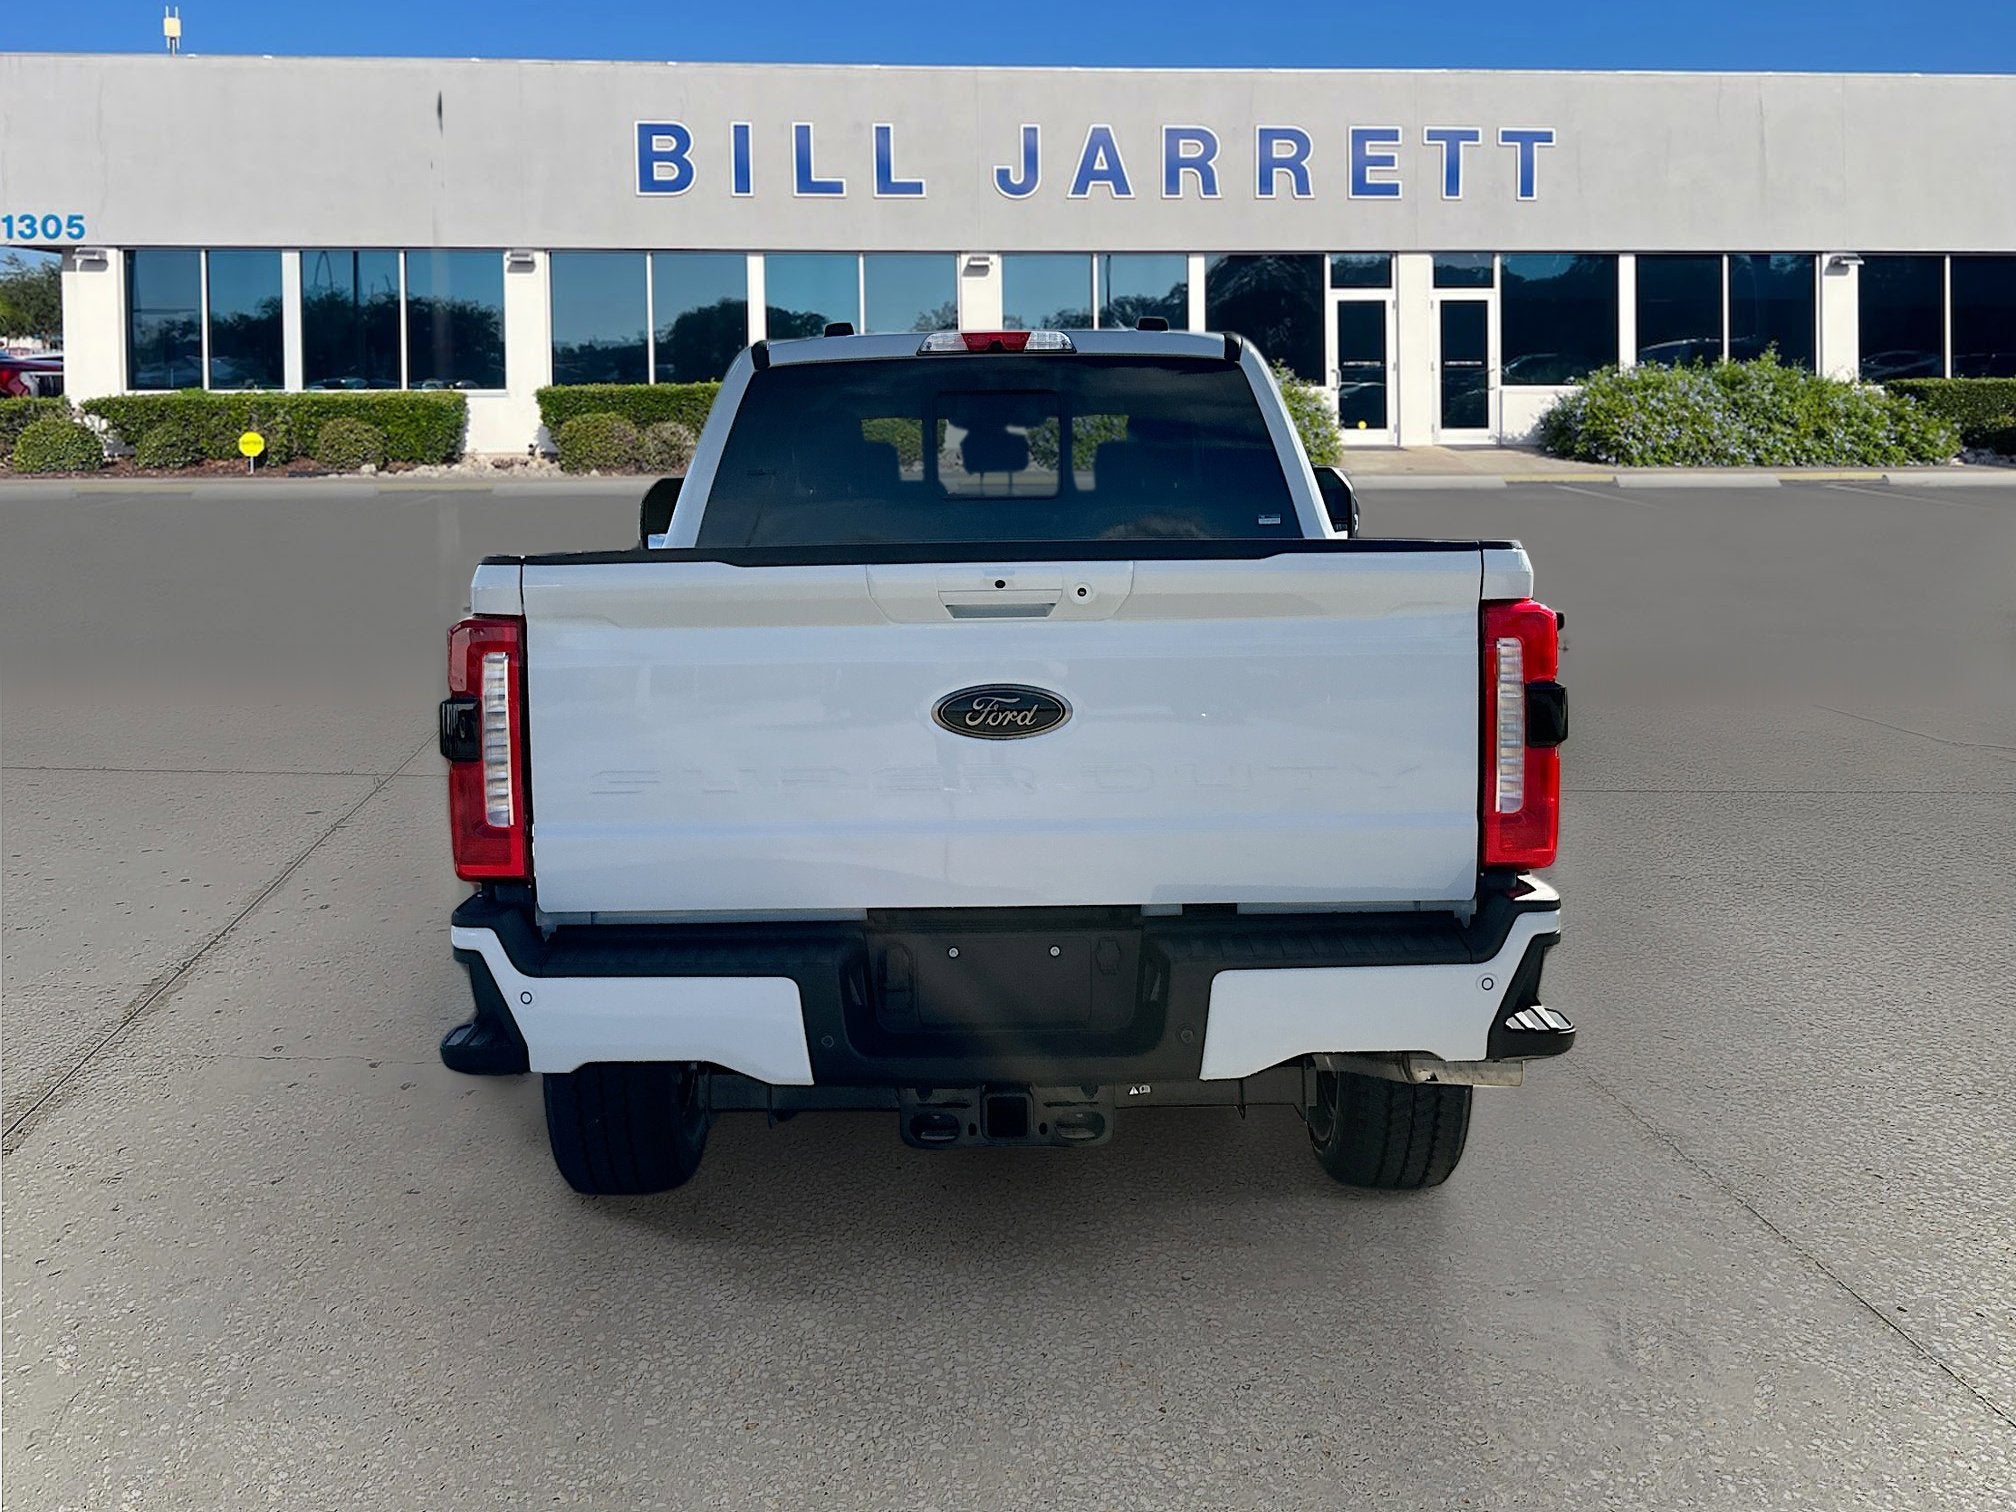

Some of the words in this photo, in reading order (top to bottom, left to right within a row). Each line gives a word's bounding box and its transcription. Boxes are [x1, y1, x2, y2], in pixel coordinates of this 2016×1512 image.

[634, 121, 926, 198] BILL
[993, 124, 1557, 201] JARRETT
[1, 213, 86, 240] 1305
[965, 696, 1039, 727] Ford
